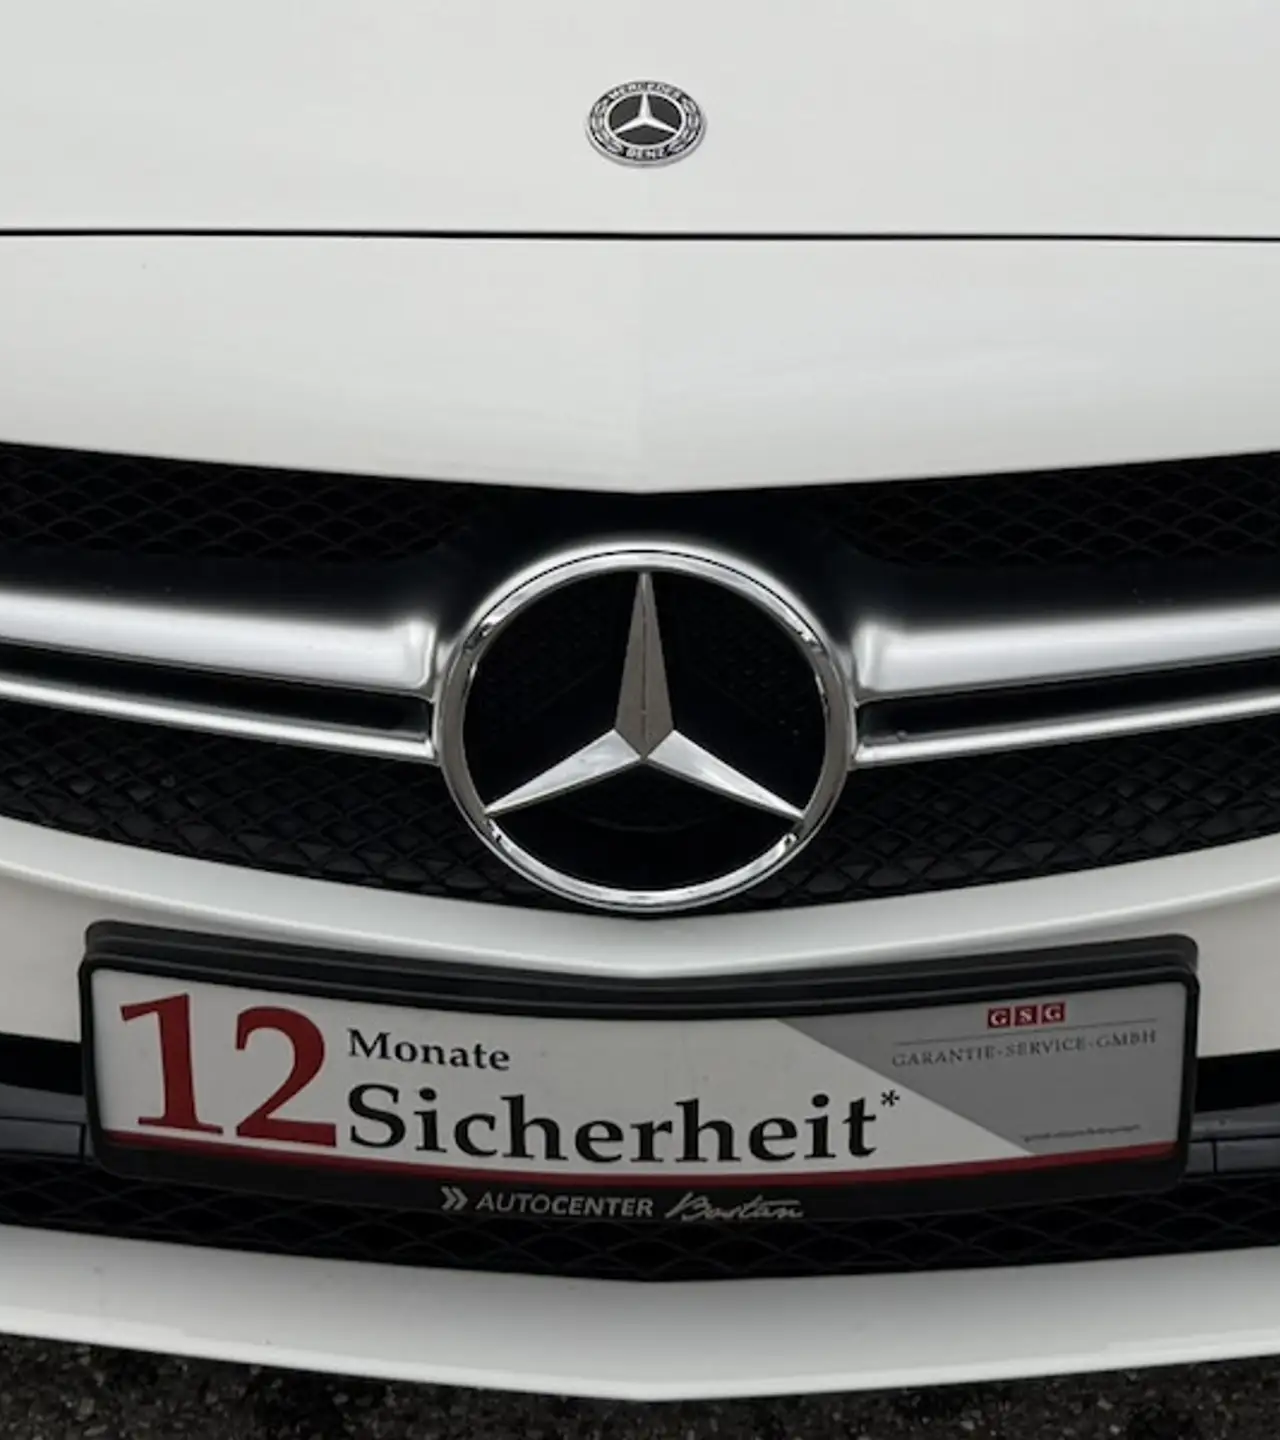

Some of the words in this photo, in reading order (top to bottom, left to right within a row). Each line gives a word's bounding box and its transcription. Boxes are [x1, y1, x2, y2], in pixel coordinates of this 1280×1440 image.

[988, 1003, 1065, 1029] GSG
[120, 992, 337, 1148] 12
[347, 1028, 510, 1071] Monate
[475, 1191, 654, 1218] AUTOCENTER
